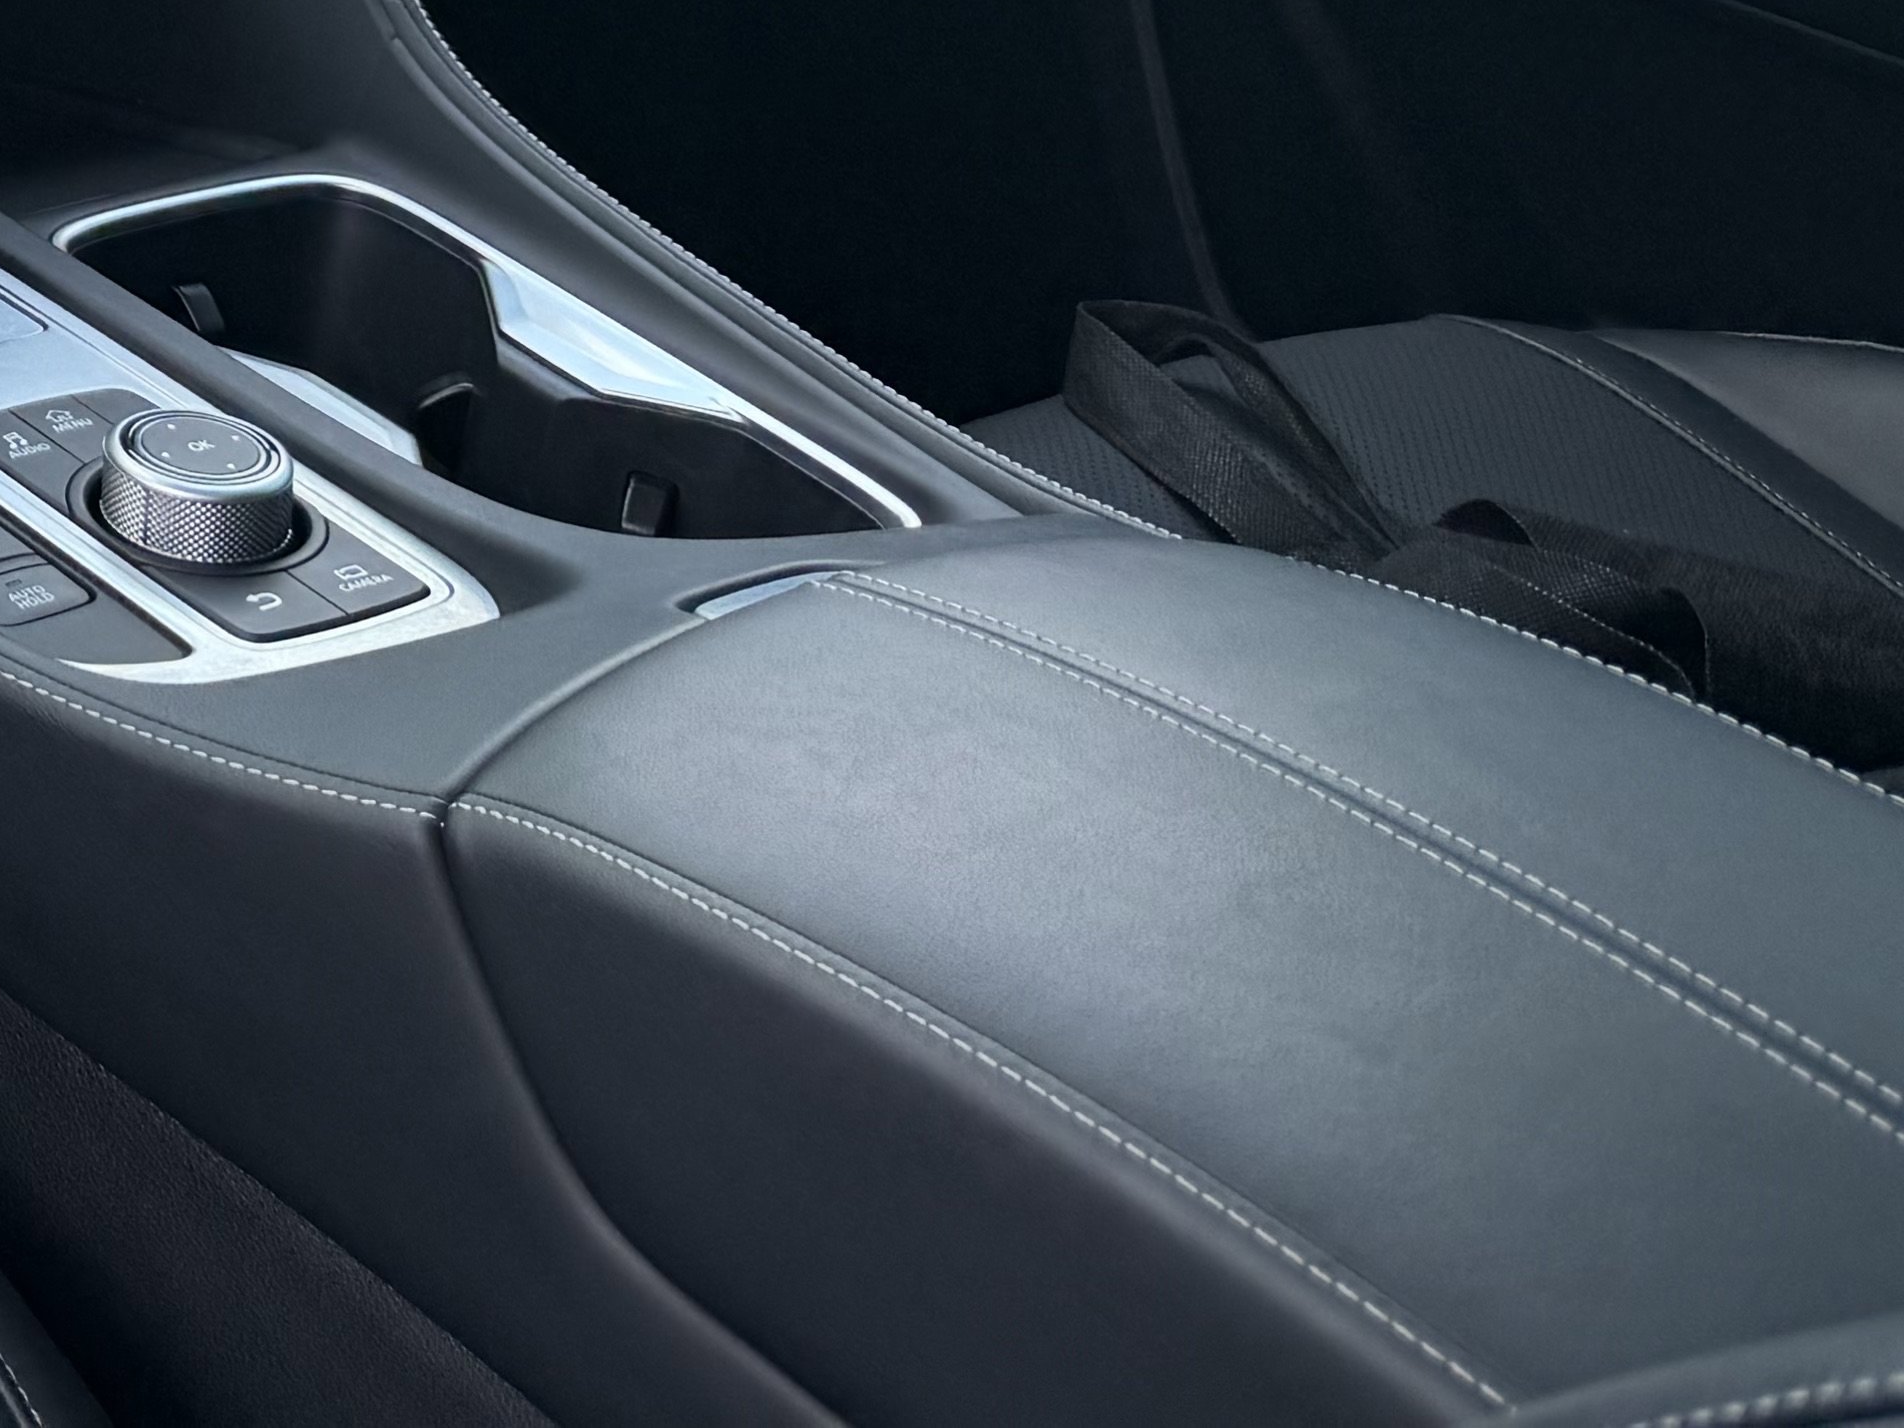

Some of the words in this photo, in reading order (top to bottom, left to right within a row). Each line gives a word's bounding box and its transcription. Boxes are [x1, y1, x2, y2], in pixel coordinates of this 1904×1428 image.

[52, 417, 94, 434] MENU
[8, 442, 51, 459] AUDIO
[187, 439, 216, 453] OK
[8, 584, 46, 602] AUTO
[14, 592, 55, 611] HOLD
